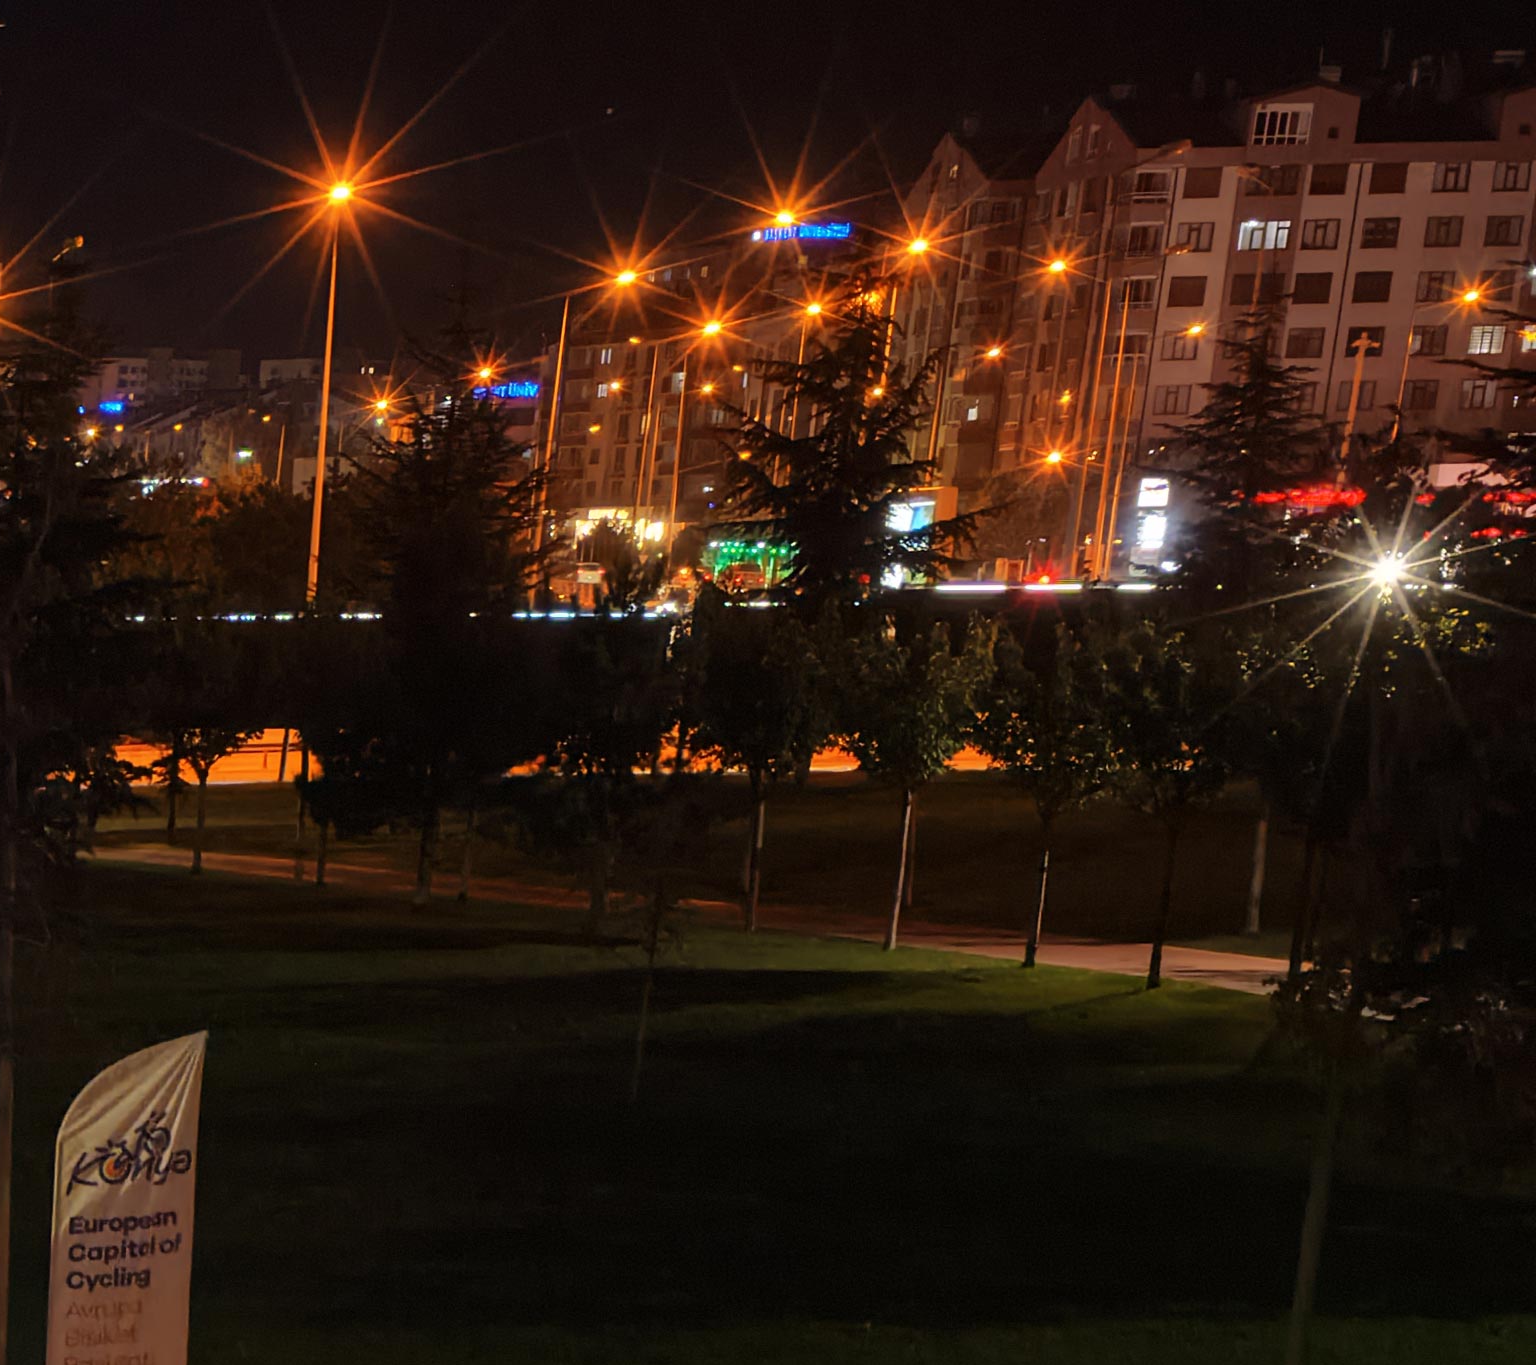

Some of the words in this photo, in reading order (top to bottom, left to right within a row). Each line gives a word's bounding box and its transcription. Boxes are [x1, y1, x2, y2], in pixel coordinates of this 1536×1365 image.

[68, 1210, 177, 1237] European
[68, 1235, 155, 1265] Capital
[159, 1232, 182, 1254] of
[66, 1269, 151, 1292] Cycling
